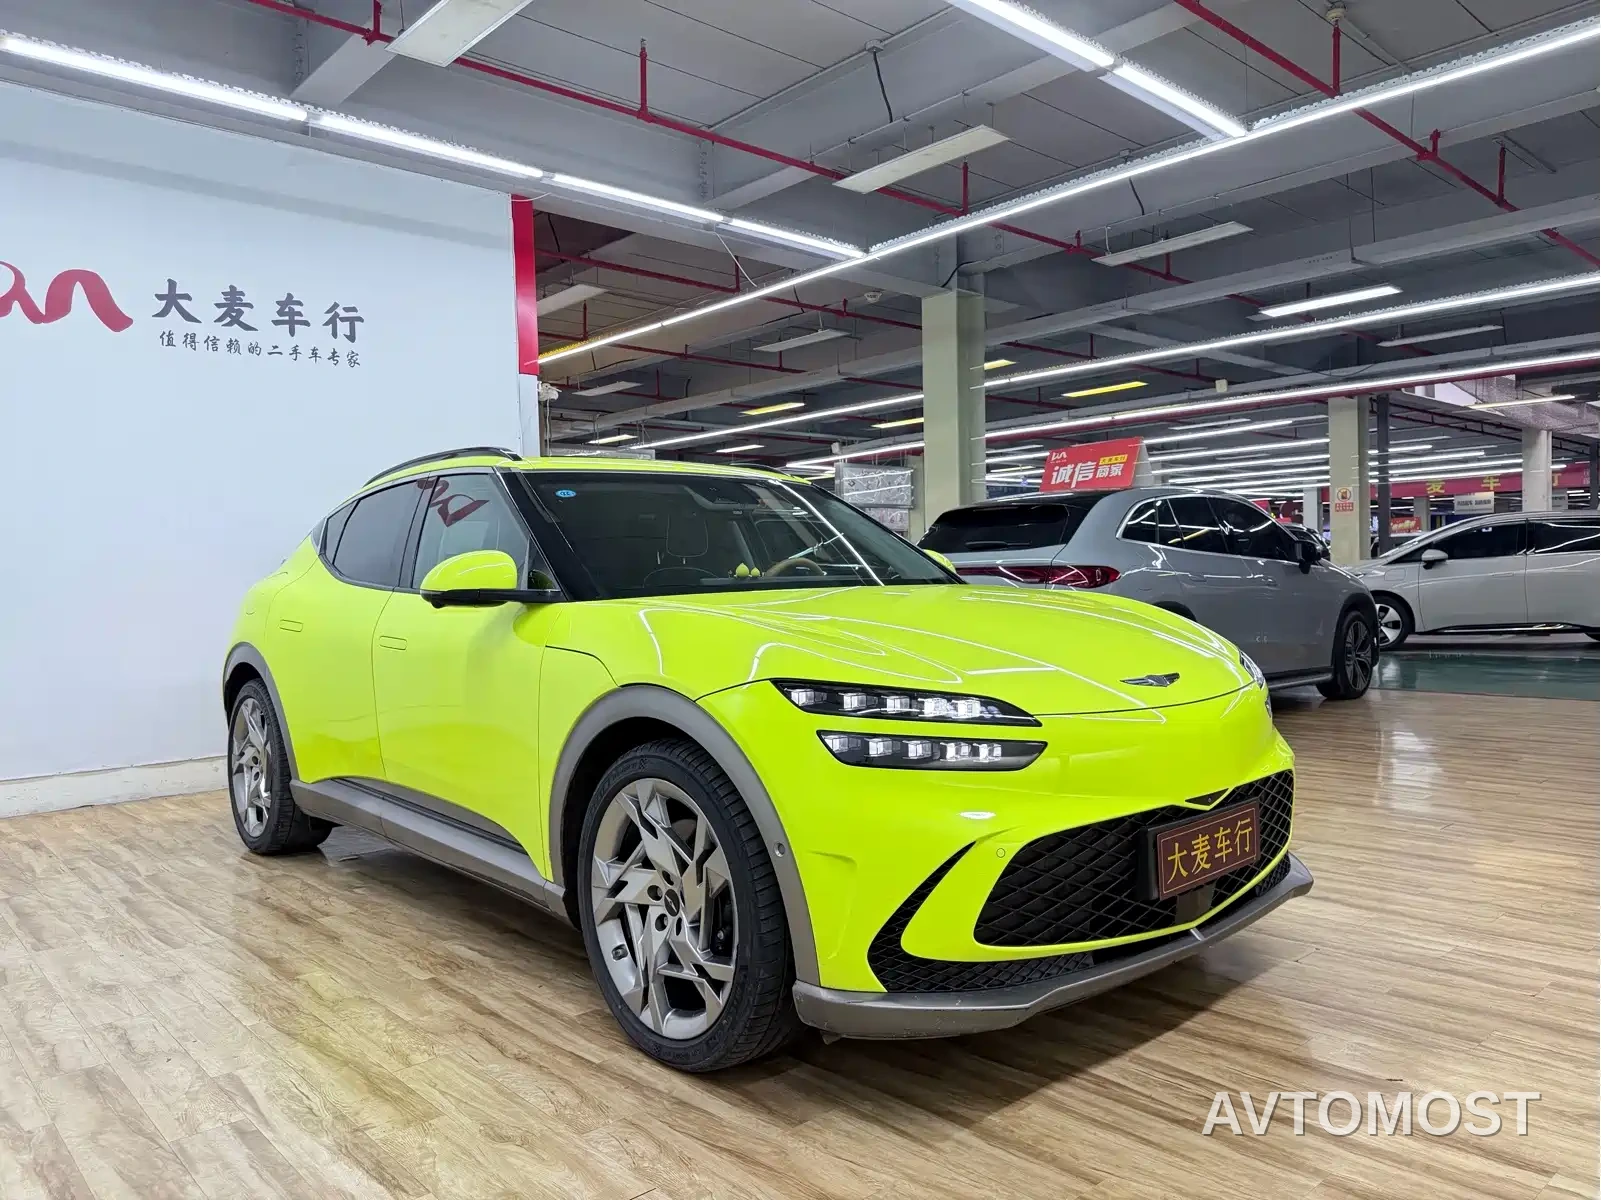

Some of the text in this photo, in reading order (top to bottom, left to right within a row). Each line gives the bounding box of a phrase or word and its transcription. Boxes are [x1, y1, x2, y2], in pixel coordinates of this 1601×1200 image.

[151, 278, 365, 343] 大麦车行
[159, 330, 361, 368] 值得信赖的二手车专家
[1050, 461, 1124, 489] 诚信商家
[1167, 817, 1253, 884] 大麦车行
